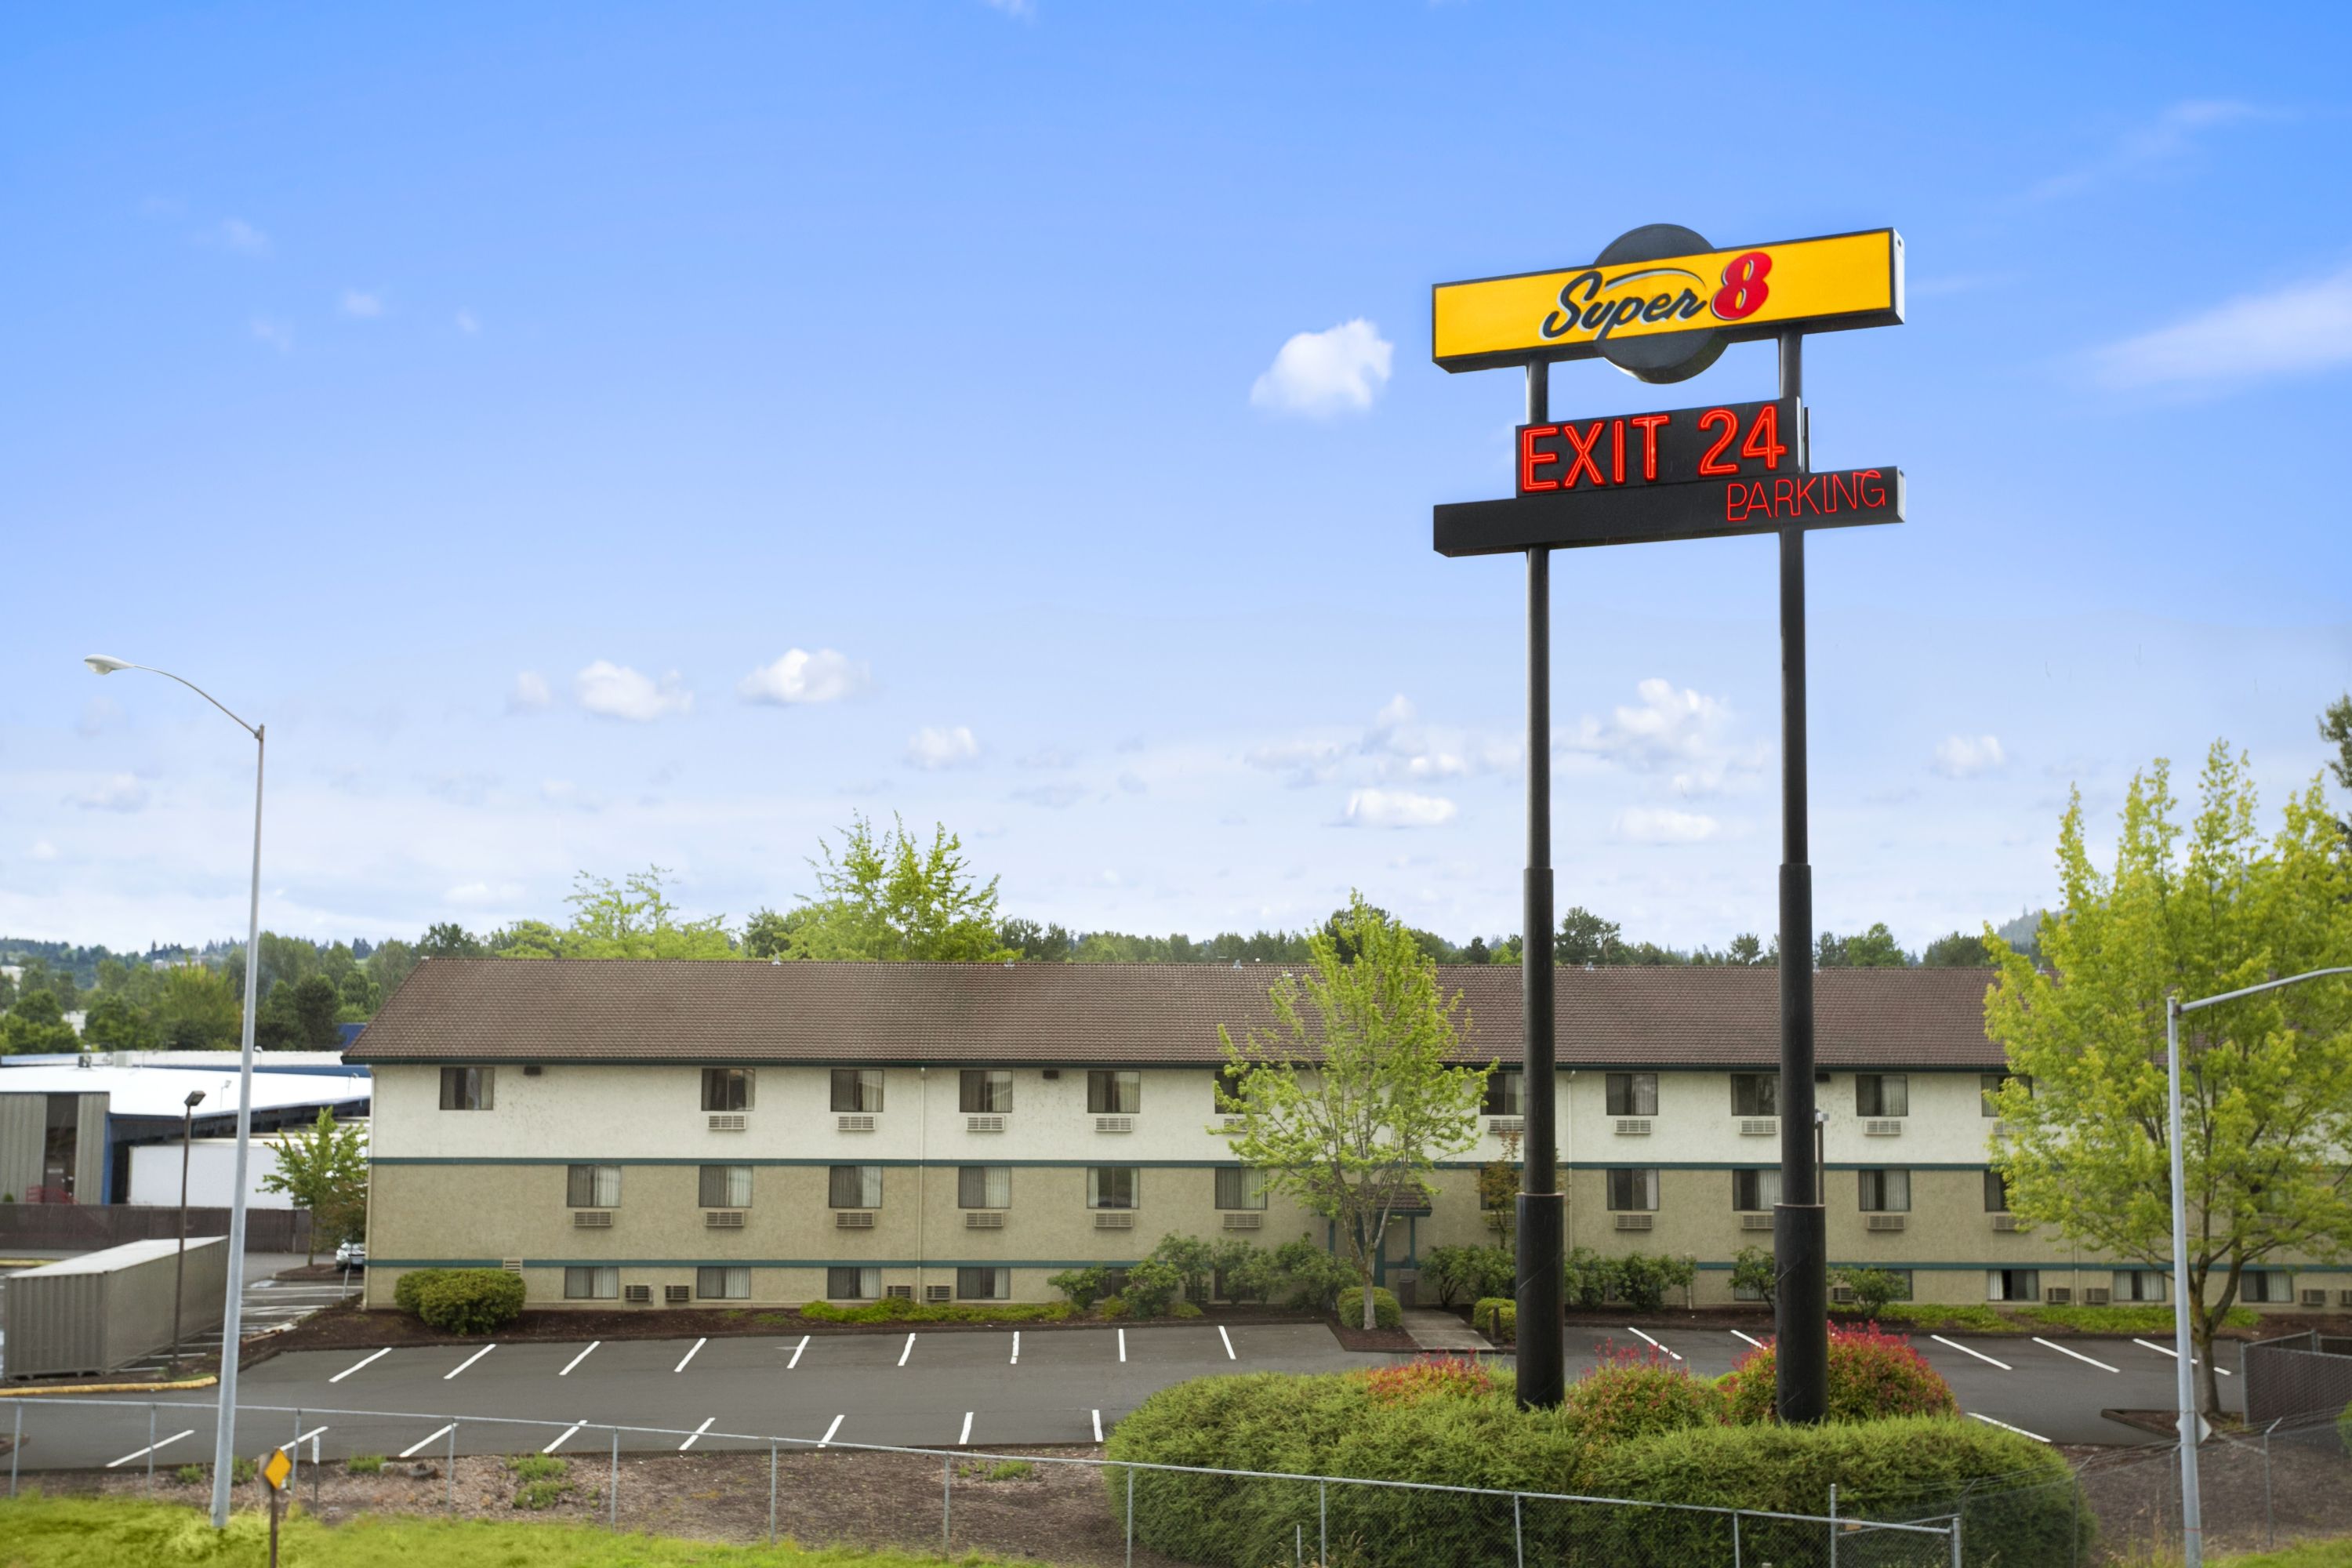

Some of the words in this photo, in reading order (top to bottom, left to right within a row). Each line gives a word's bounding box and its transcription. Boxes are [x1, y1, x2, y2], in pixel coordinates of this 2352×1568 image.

[1539, 270, 1708, 340] Super
[1710, 251, 1773, 321] 8
[1521, 414, 1670, 493] EXIT
[1697, 403, 1788, 477] 24
[1727, 470, 1886, 521] PARKING
